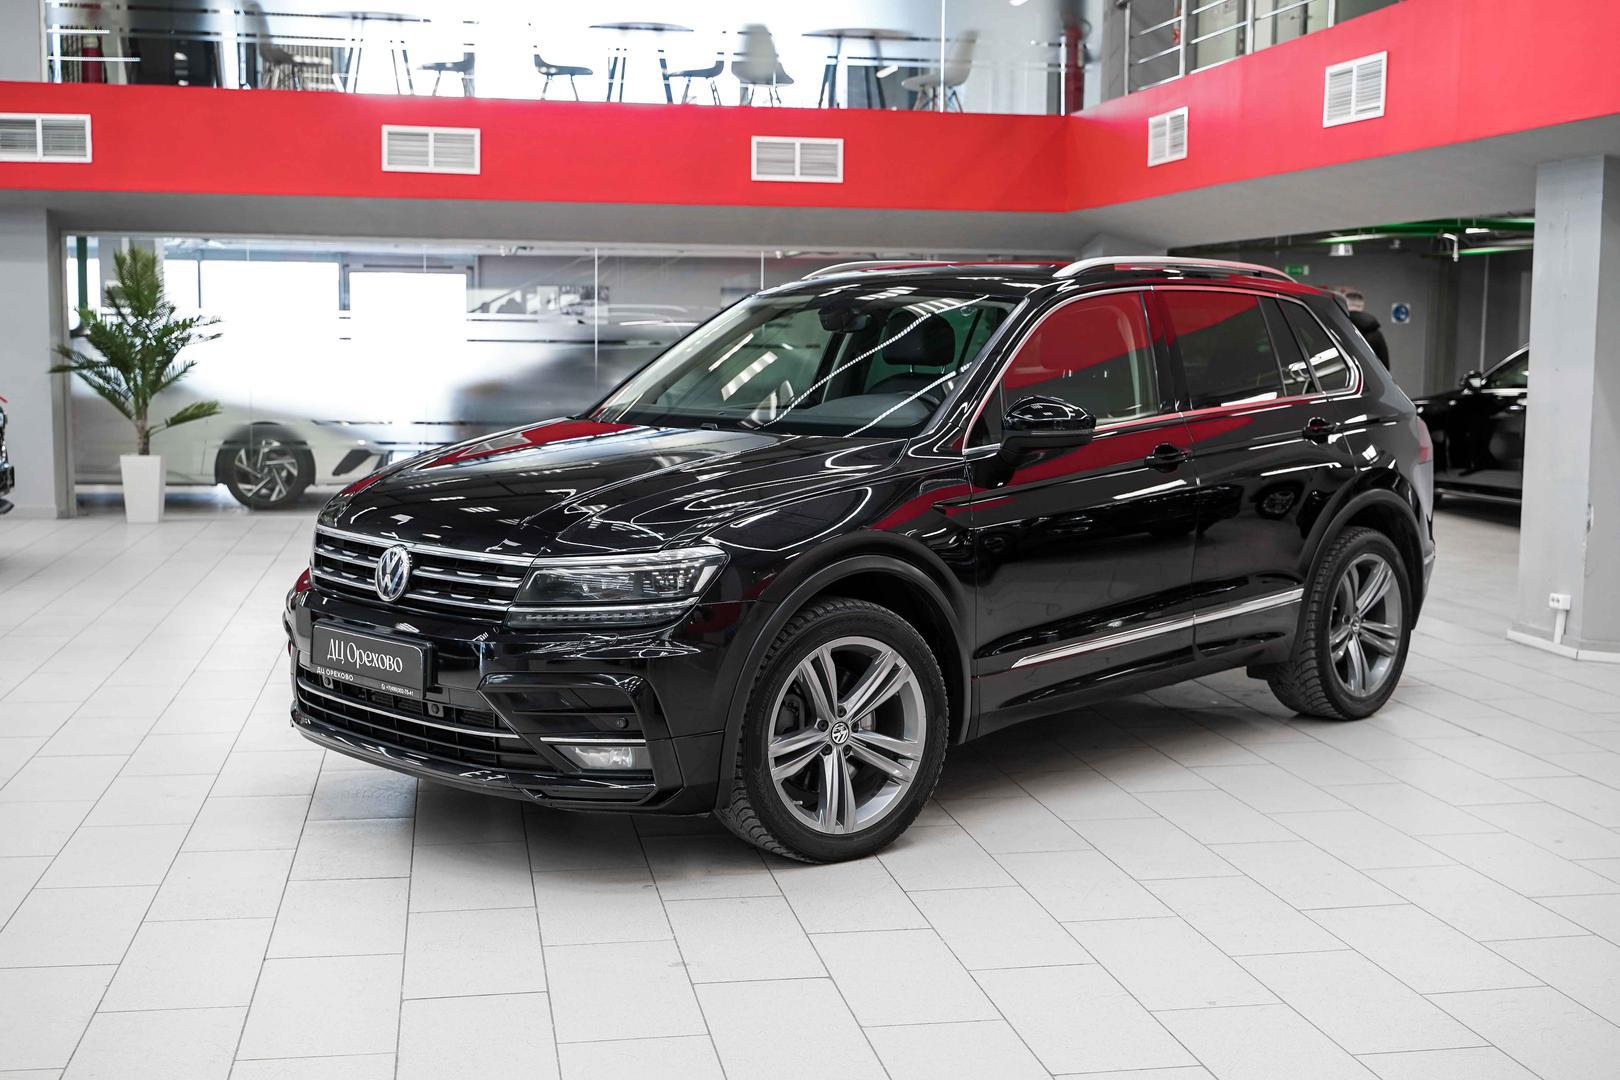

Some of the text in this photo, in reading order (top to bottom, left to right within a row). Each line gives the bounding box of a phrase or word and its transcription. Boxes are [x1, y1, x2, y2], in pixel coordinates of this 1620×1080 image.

[327, 638, 403, 673] ДЦ Орехово
[325, 668, 354, 681] ОРЕХОВО
